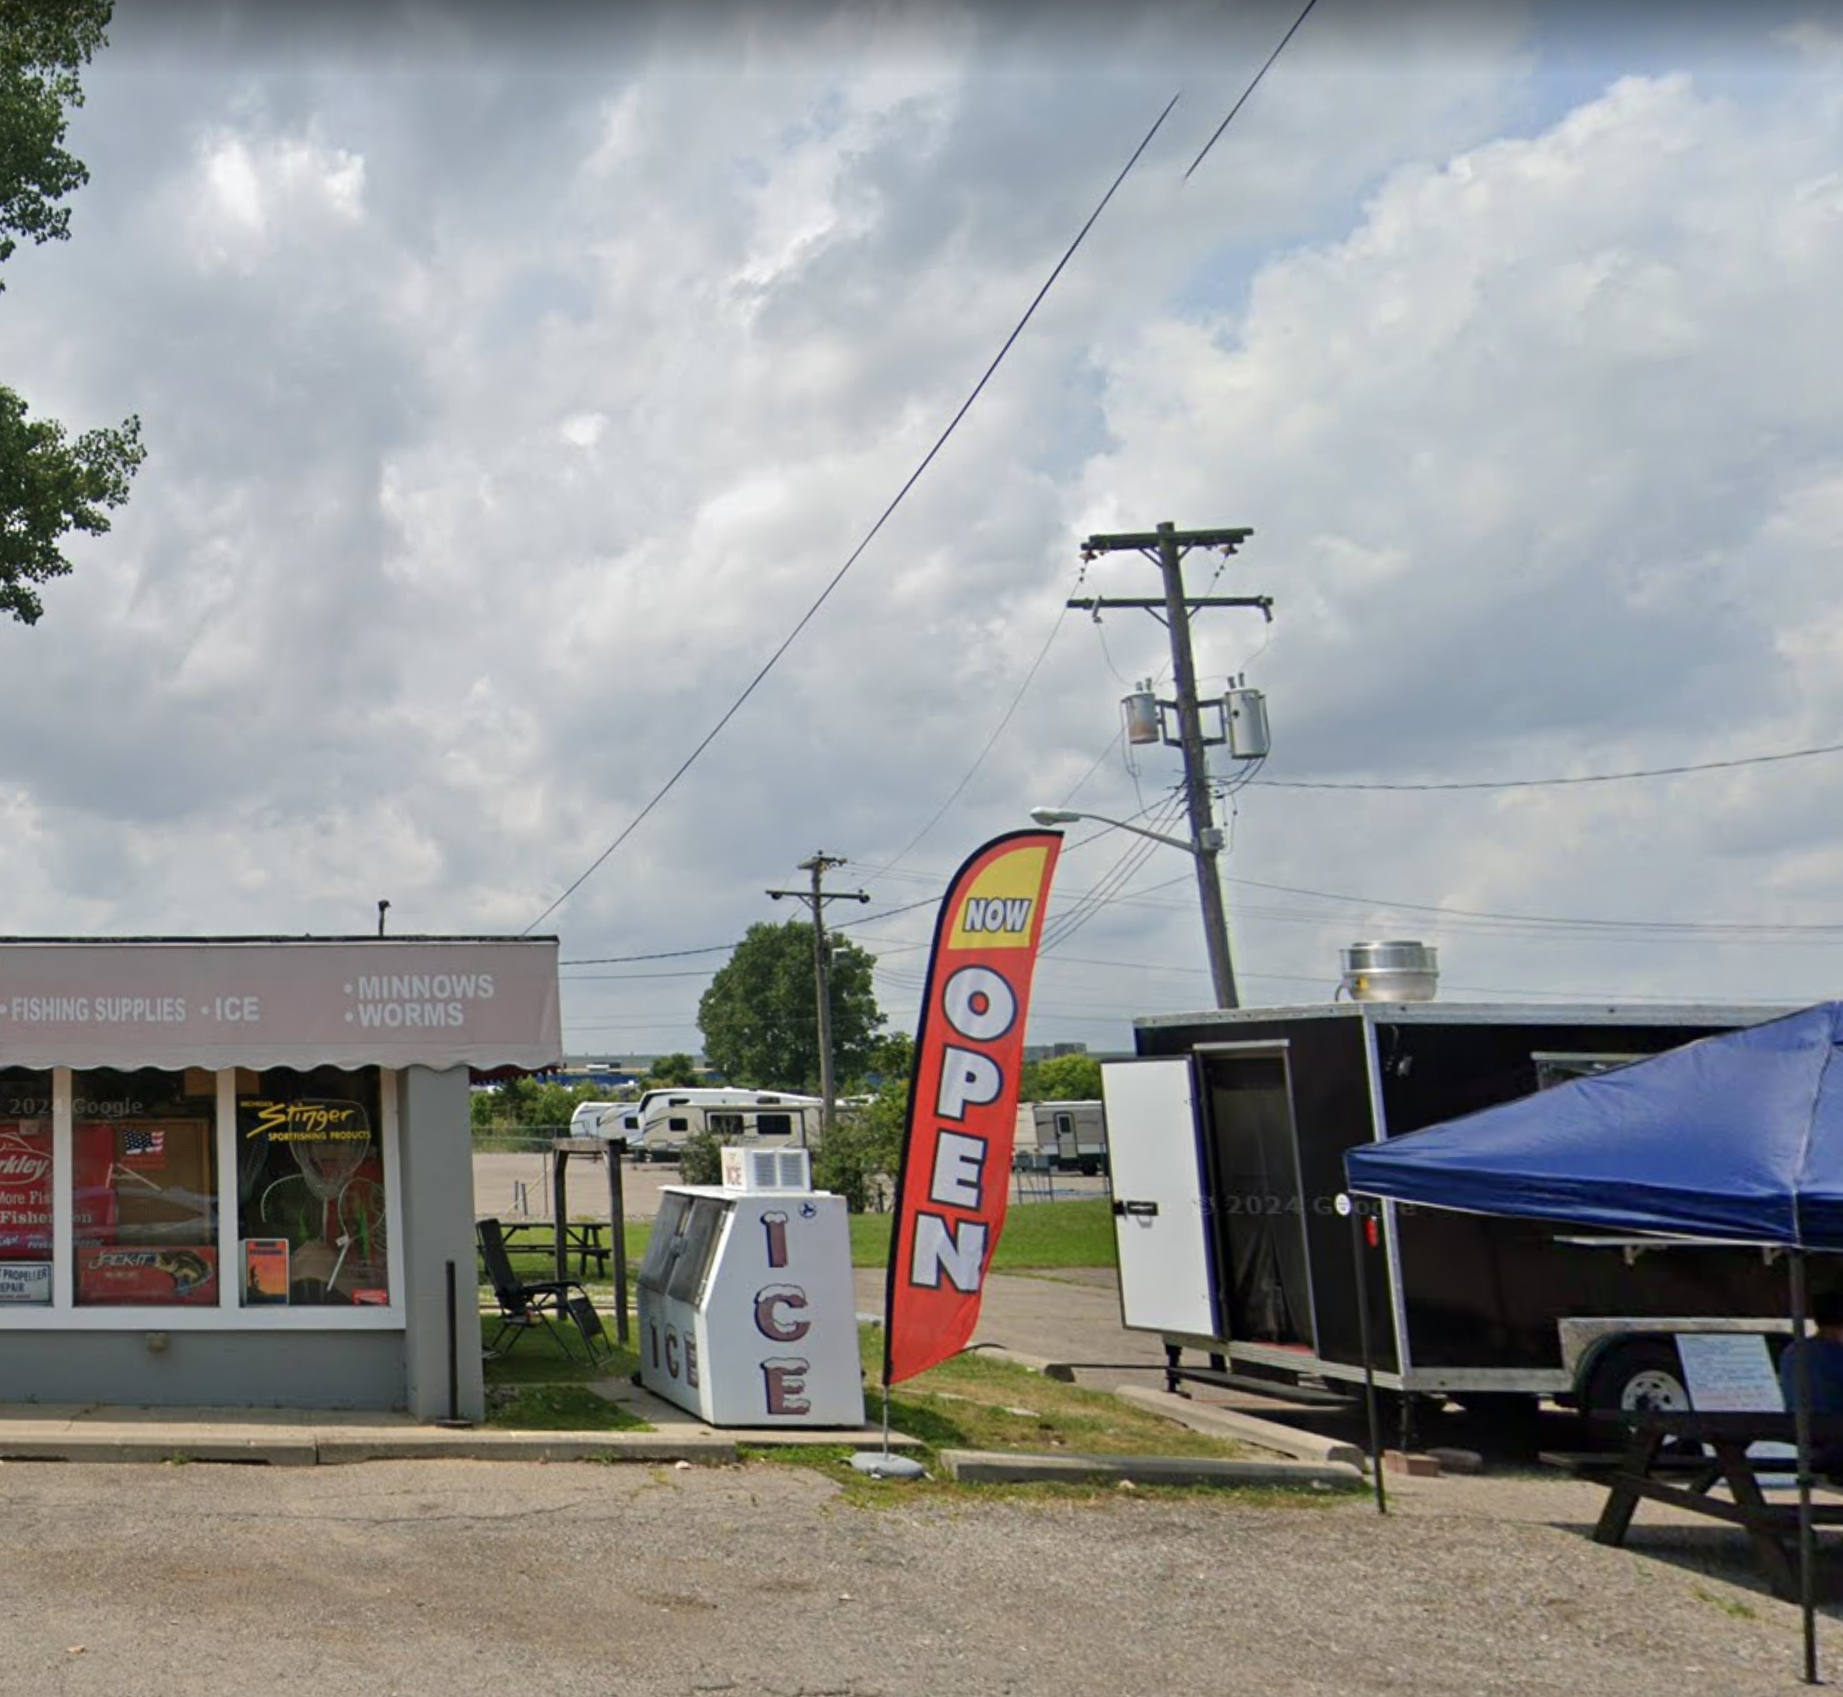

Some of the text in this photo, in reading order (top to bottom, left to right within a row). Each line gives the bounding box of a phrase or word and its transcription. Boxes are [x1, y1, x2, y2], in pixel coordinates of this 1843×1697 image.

[962, 897, 1032, 933] NOW
[358, 974, 494, 999] MINNOWS
[11, 998, 186, 1022] FISHING SUPPLIES
[215, 996, 260, 1021] ICE
[359, 1002, 465, 1028] WORMS
[246, 1103, 355, 1139] Stinger
[908, 964, 1019, 1295] OPEN
[329, 1131, 371, 1140] PRODUCTS
[3, 1268, 47, 1280] PROPELLER
[754, 1210, 812, 1415] ICE
[649, 1319, 699, 1389] ICE
